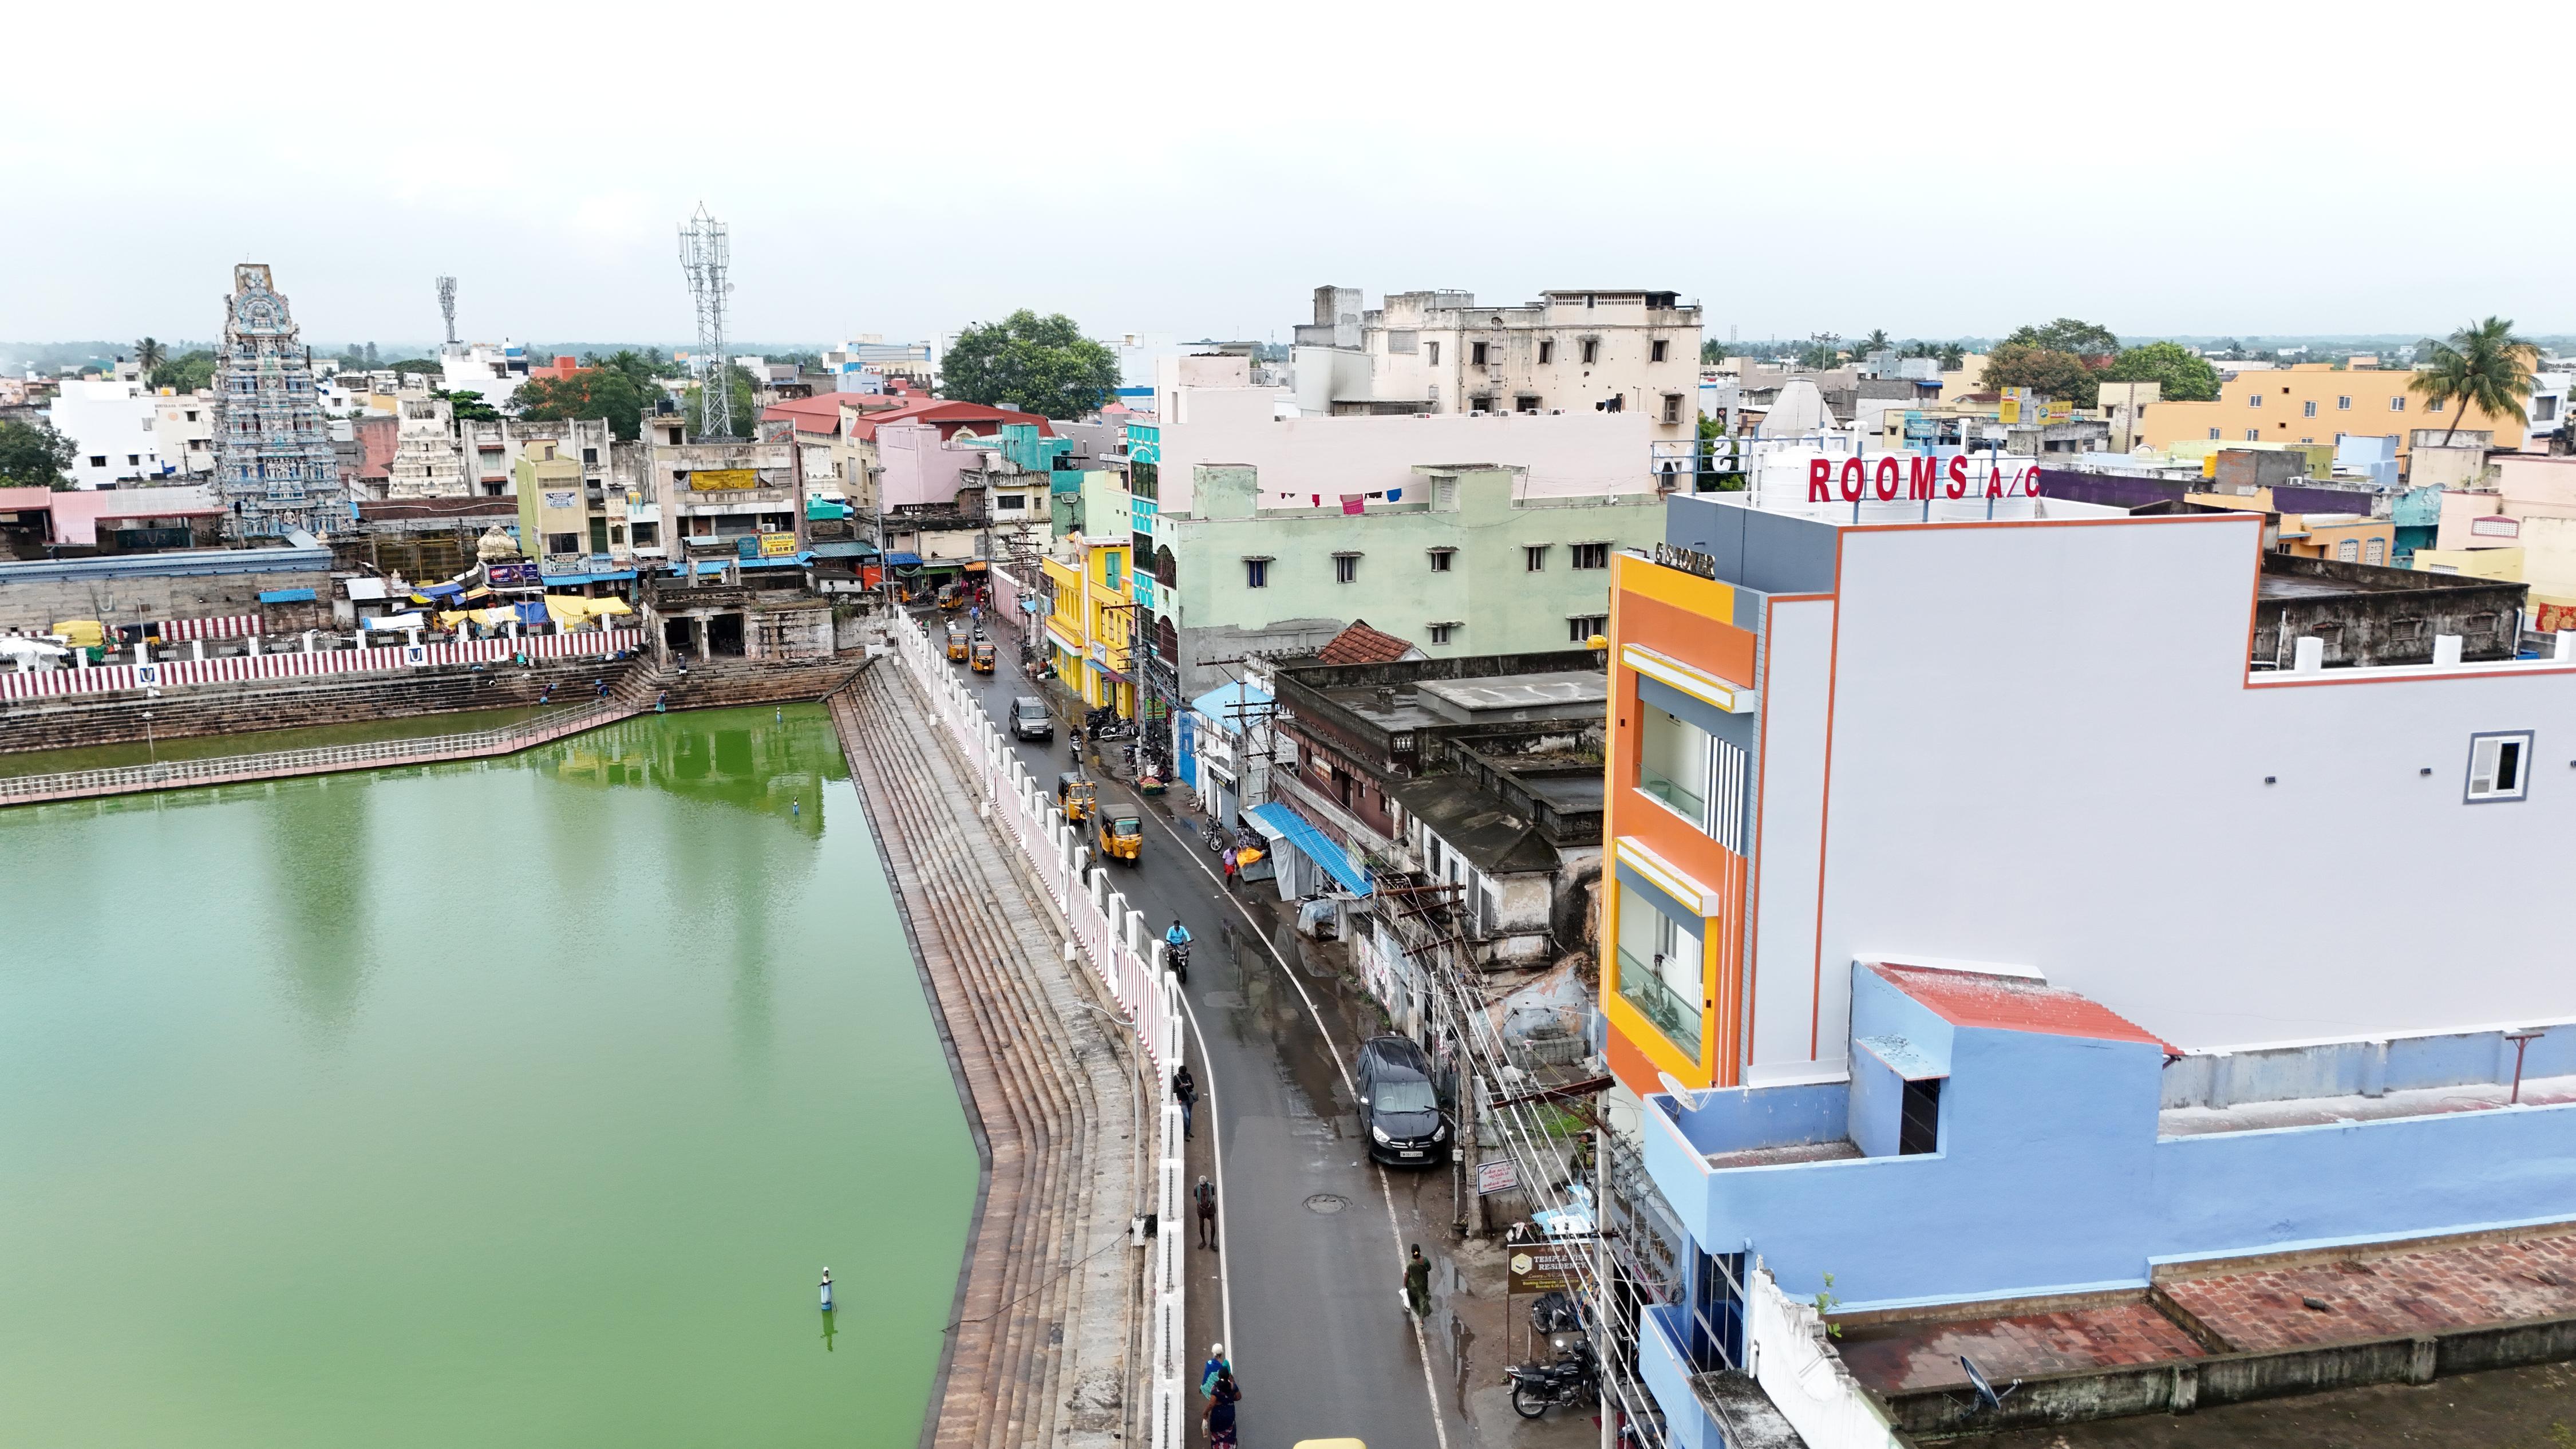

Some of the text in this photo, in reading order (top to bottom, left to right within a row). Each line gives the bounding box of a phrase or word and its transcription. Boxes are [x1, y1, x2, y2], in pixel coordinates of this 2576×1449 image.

[1808, 454, 2042, 503] ROOMS A/C
[491, 568, 508, 576] CAMPA
[1213, 769, 1227, 784] STATUS
[1534, 1254, 1567, 1263] TEMPLE
[1538, 1262, 1587, 1270] RESIDENCY
